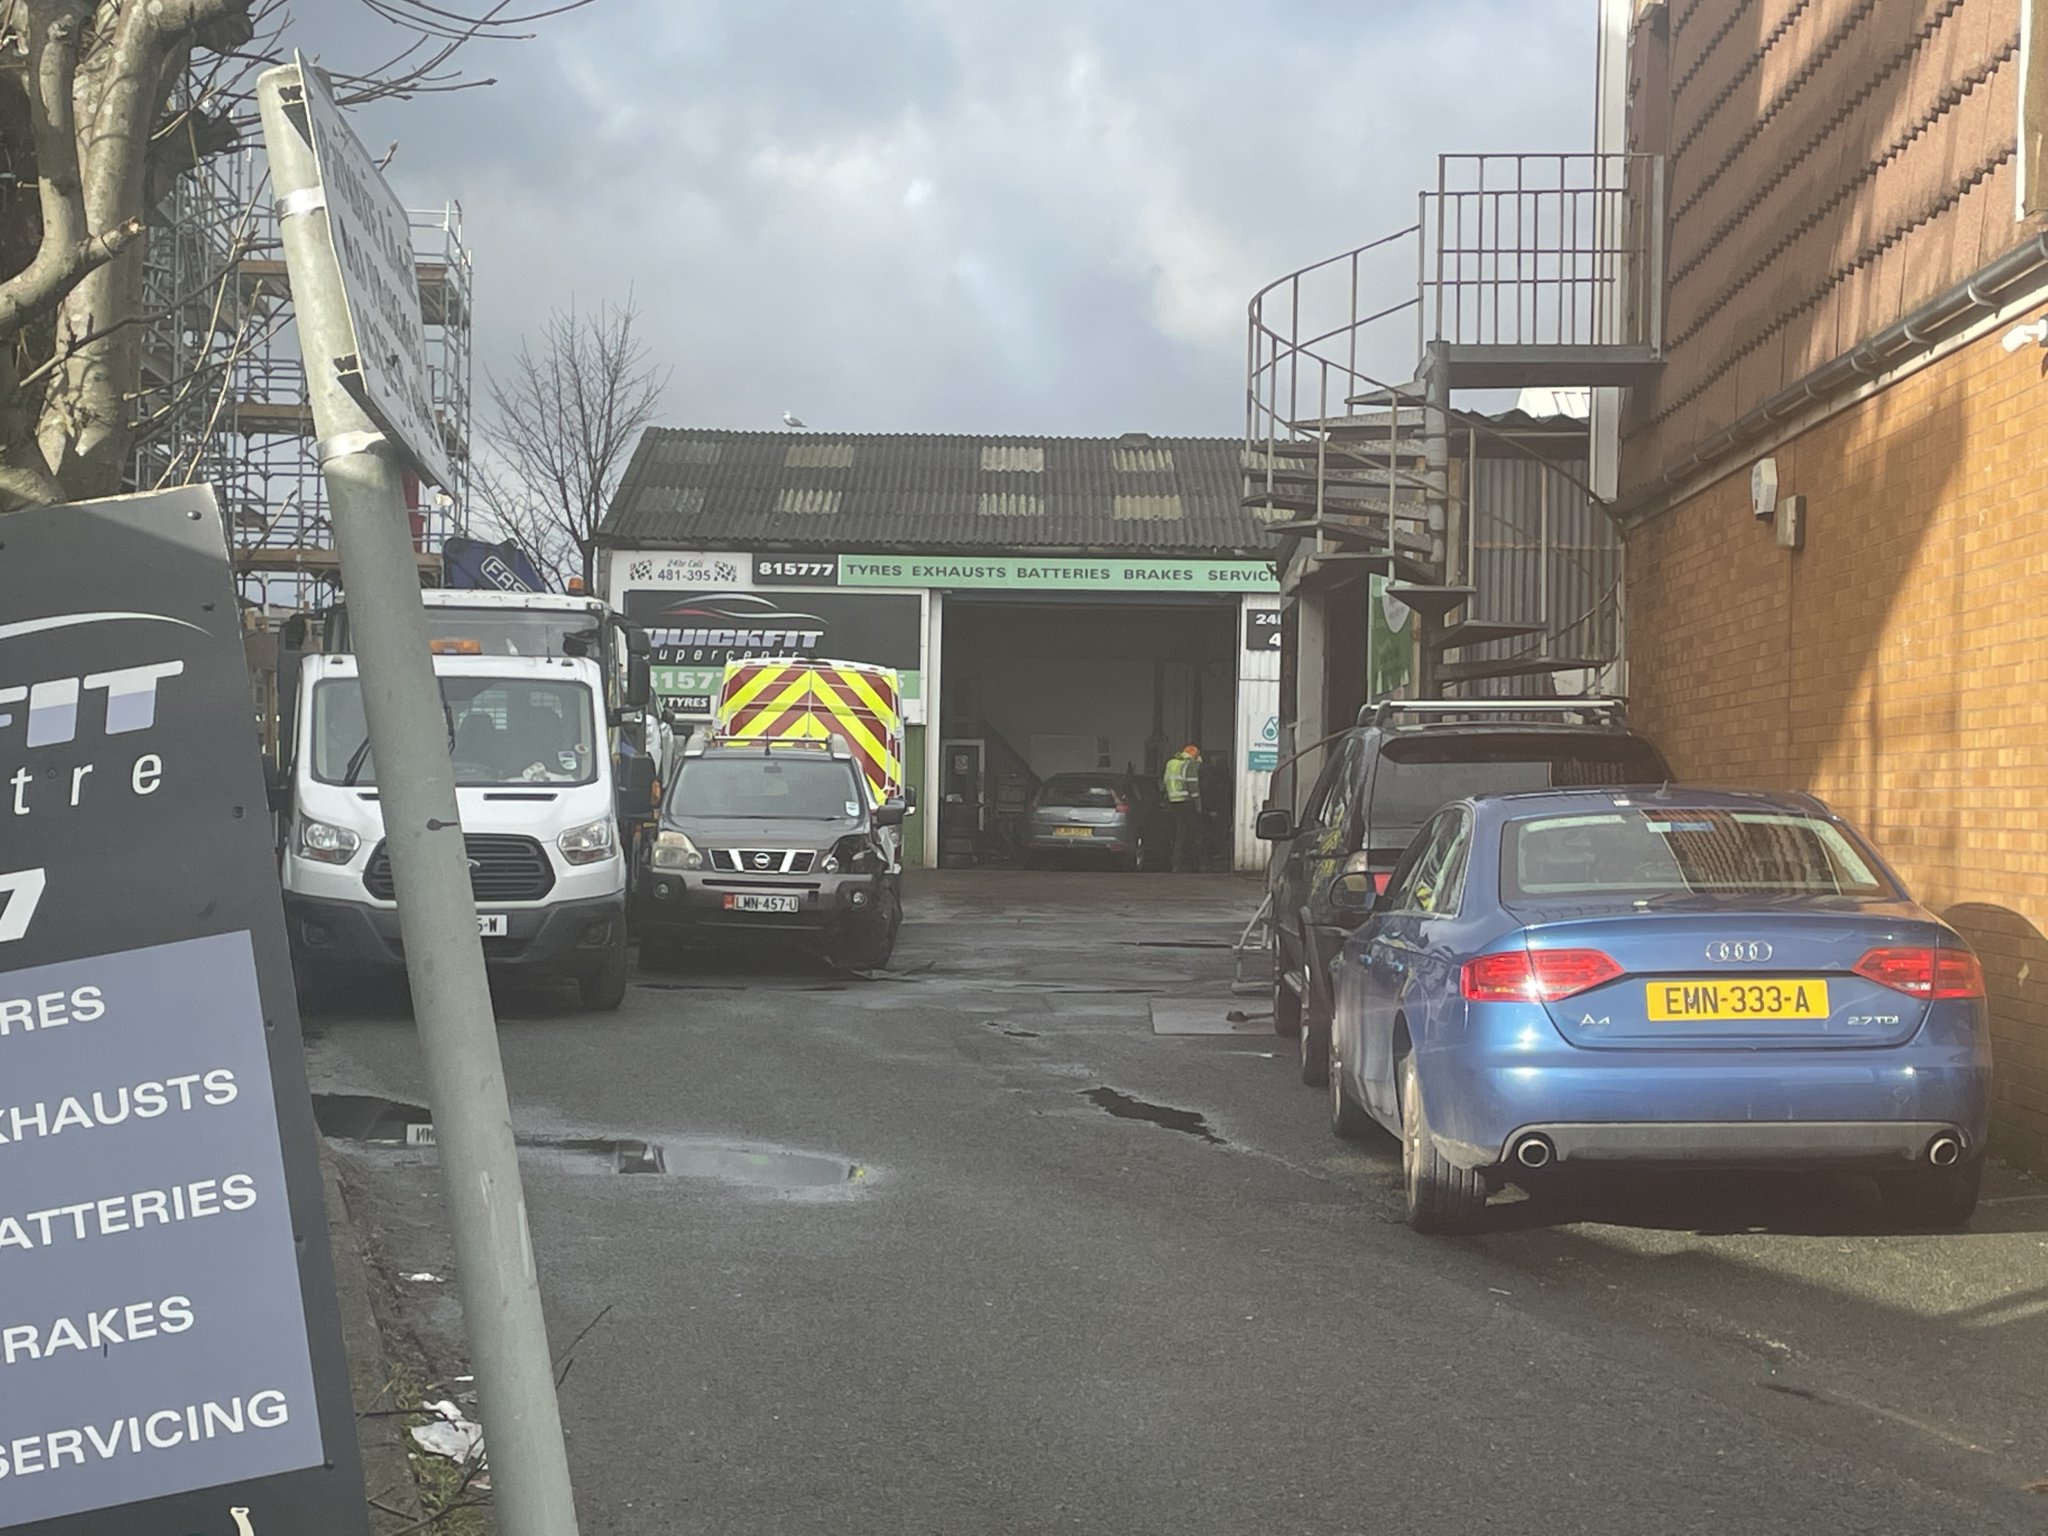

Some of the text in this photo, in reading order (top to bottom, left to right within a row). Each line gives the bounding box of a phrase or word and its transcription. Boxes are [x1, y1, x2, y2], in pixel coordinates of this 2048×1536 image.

[657, 569, 711, 581] 481-395
[759, 563, 834, 577] 815777
[847, 564, 902, 577] TYRES
[912, 565, 1007, 578] EXHAUSTS
[1017, 567, 1110, 580] BATTERIES
[1123, 568, 1193, 581] BRAKES
[667, 697, 708, 707] TYRES
[1665, 985, 1811, 1015] EMN-333-A
[1580, 1013, 1610, 1026] A4
[2, 1296, 195, 1364] RAKES
